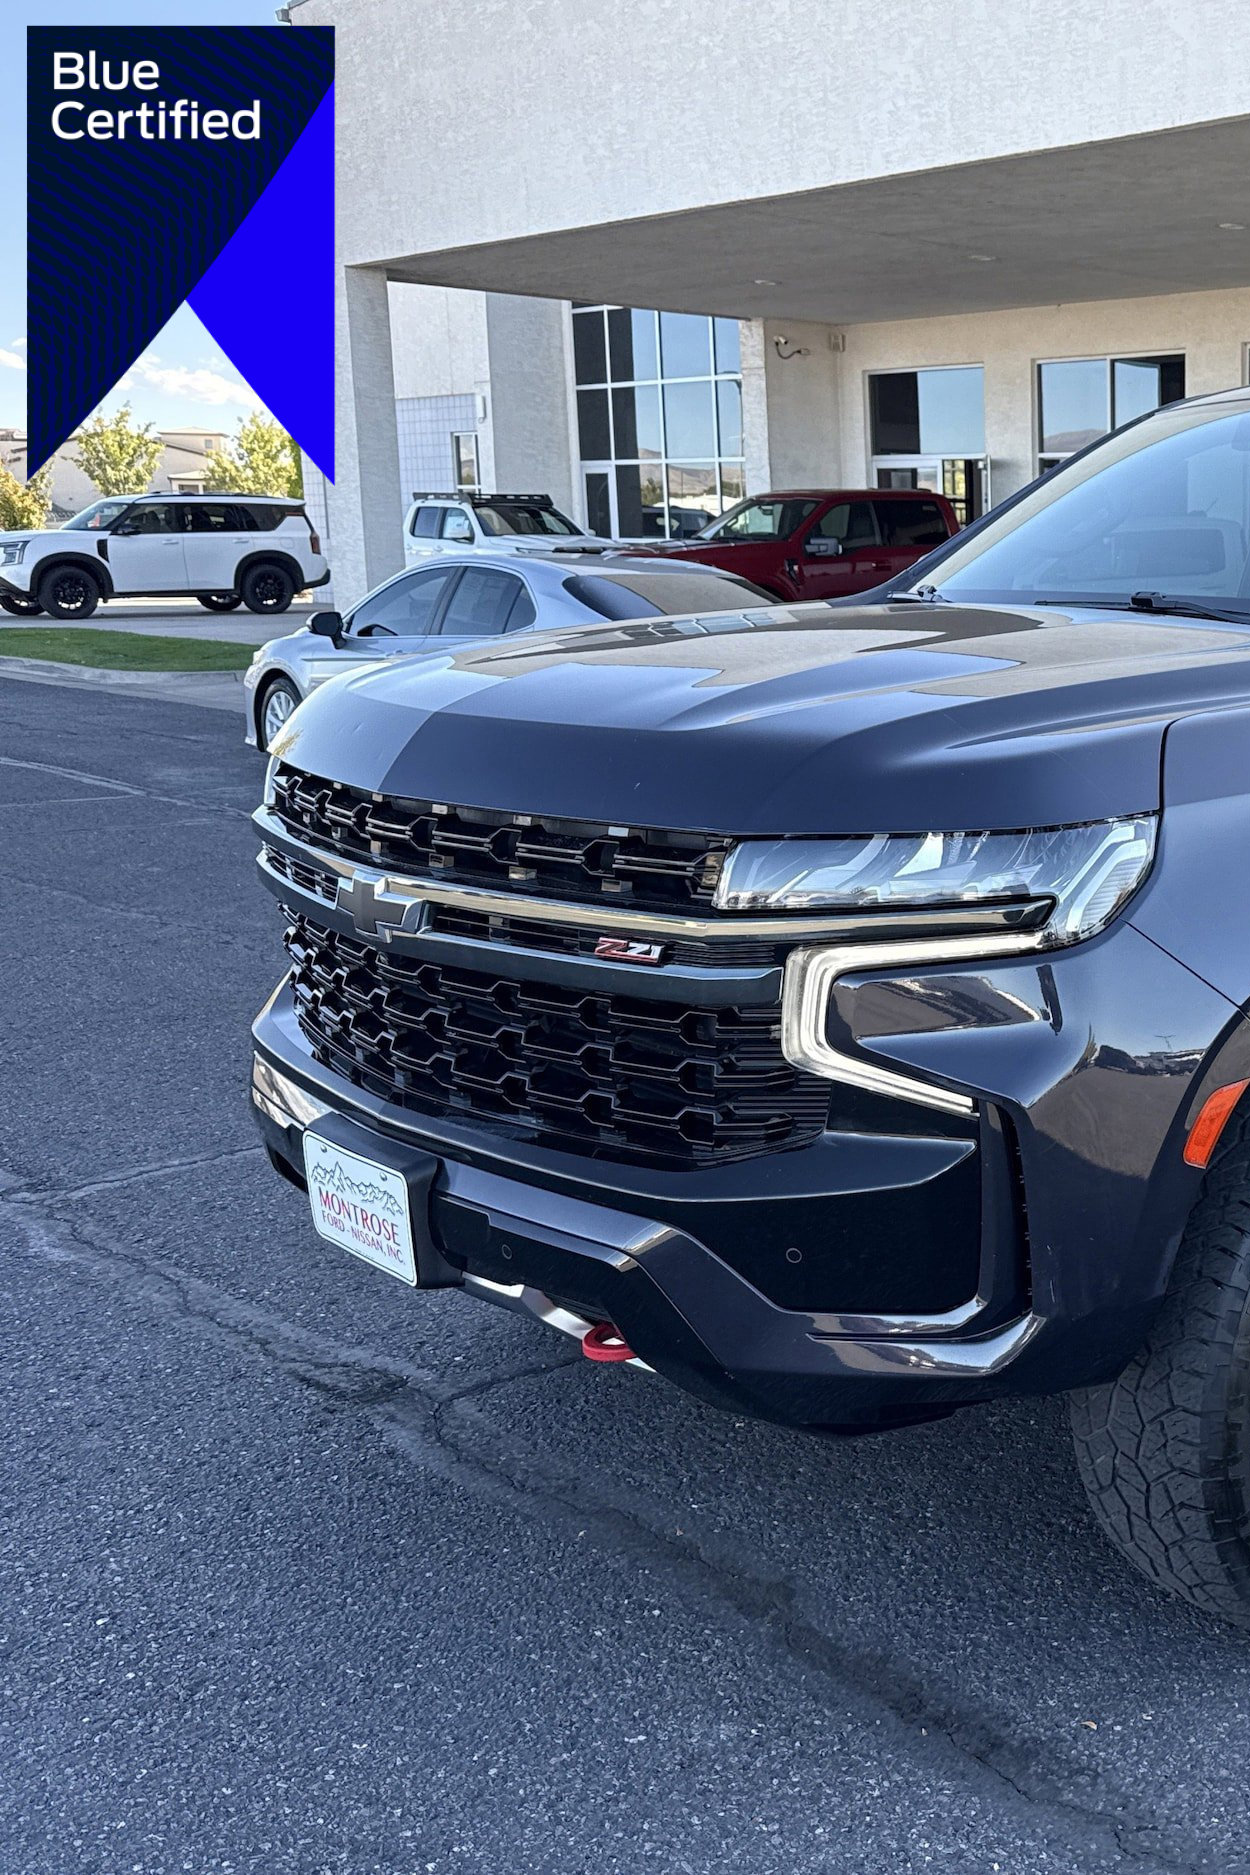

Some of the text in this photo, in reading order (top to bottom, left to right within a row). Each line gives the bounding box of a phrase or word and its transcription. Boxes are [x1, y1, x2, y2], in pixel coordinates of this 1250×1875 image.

[594, 936, 665, 963] Z71
[318, 1186, 402, 1247] MONTROSE
[321, 1210, 345, 1233] FORD
